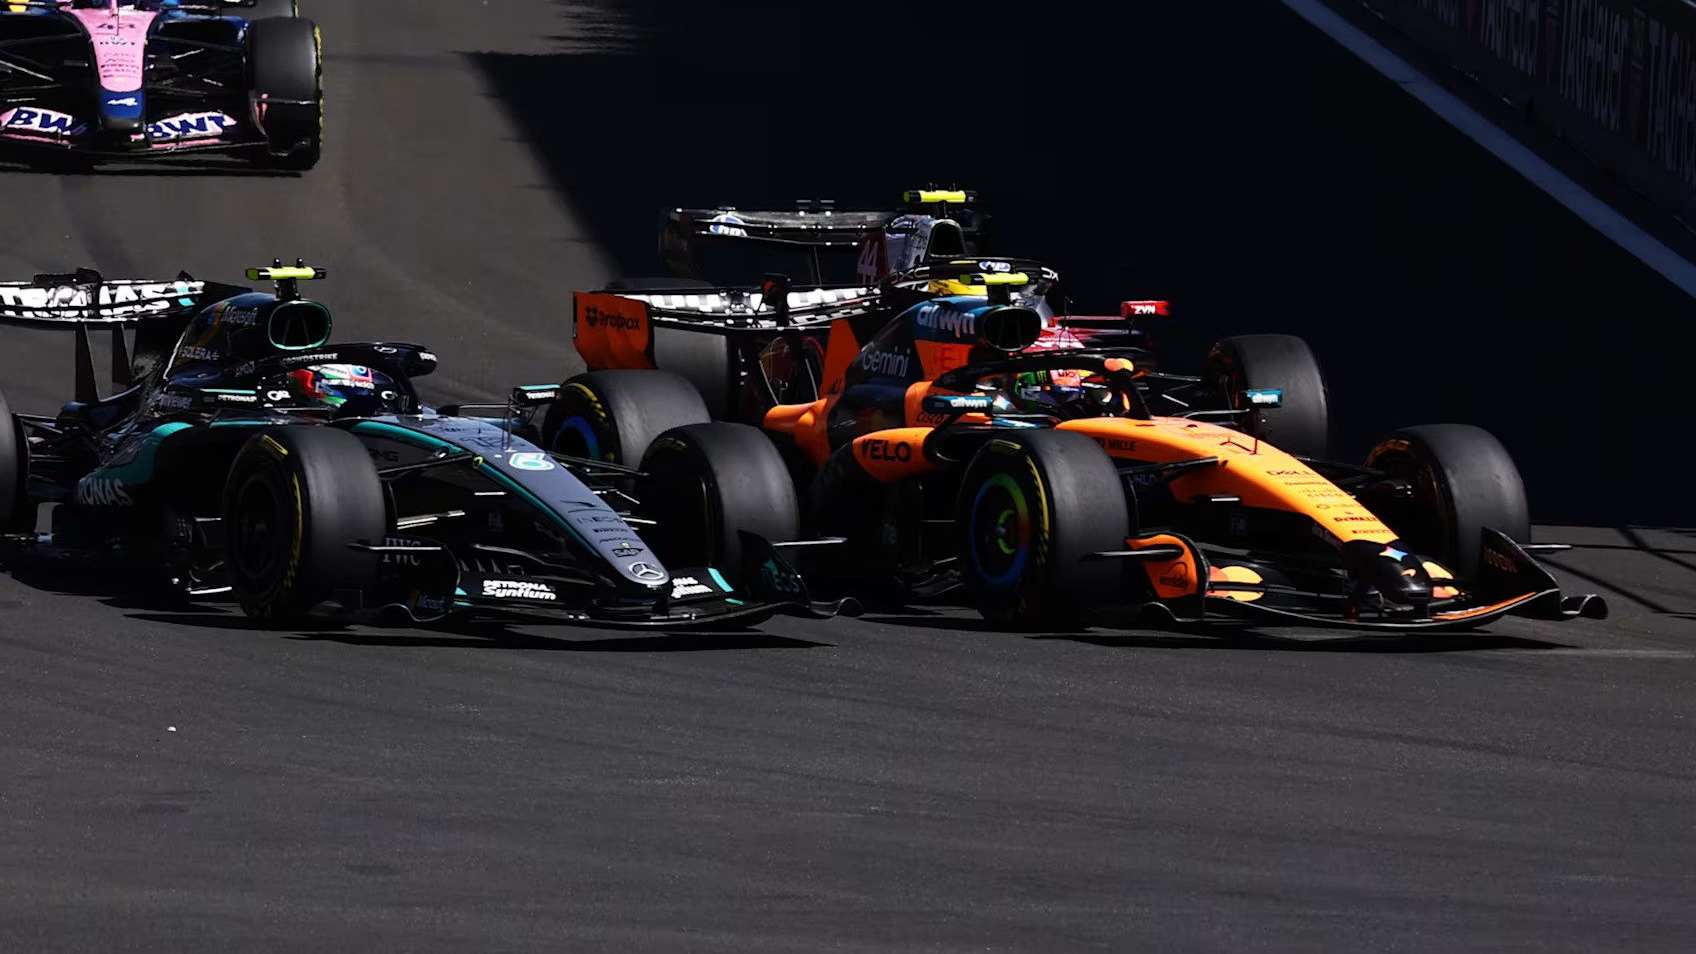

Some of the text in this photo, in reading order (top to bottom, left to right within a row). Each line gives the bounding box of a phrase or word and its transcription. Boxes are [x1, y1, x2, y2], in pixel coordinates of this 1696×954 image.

[146, 115, 226, 139] BWT
[857, 240, 878, 284] 44
[599, 311, 640, 331] Dropbox
[917, 305, 975, 339] allwyn
[863, 346, 909, 377] Gemini
[950, 397, 989, 409] allwyn
[861, 439, 911, 462] VELO
[482, 587, 556, 601] Syntium
